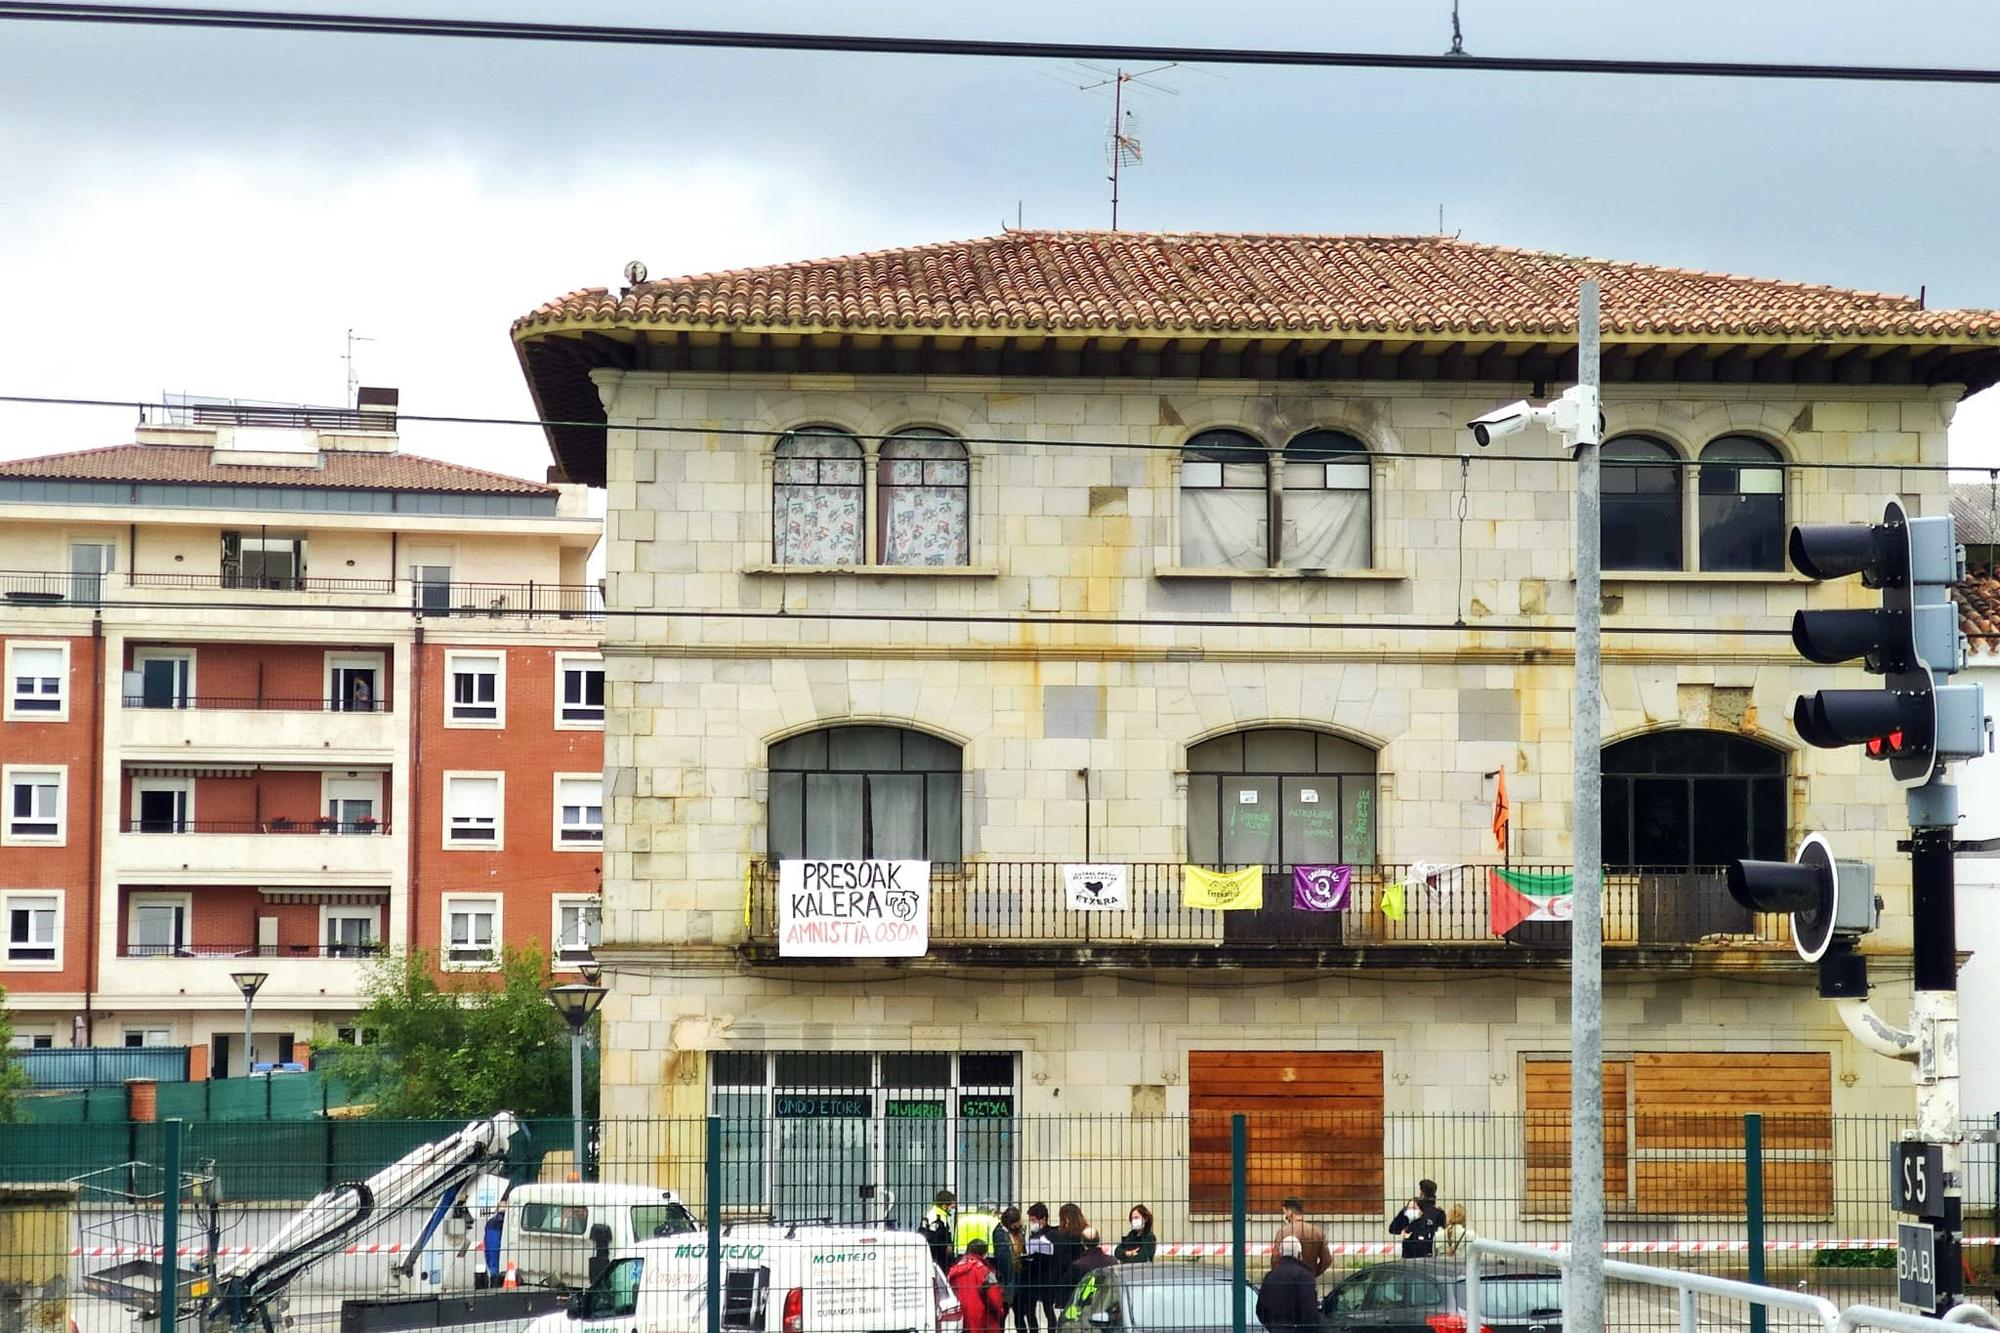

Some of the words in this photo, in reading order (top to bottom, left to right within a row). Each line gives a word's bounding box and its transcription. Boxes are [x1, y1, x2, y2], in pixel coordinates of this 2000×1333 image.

[803, 861, 902, 890] PRESOAK
[792, 890, 883, 918] KALERA
[874, 921, 919, 942] OSOA
[674, 1243, 765, 1260] MOTEJO
[813, 1252, 876, 1264] MONTEJO
[1899, 1247, 1933, 1285] B.A.B.
